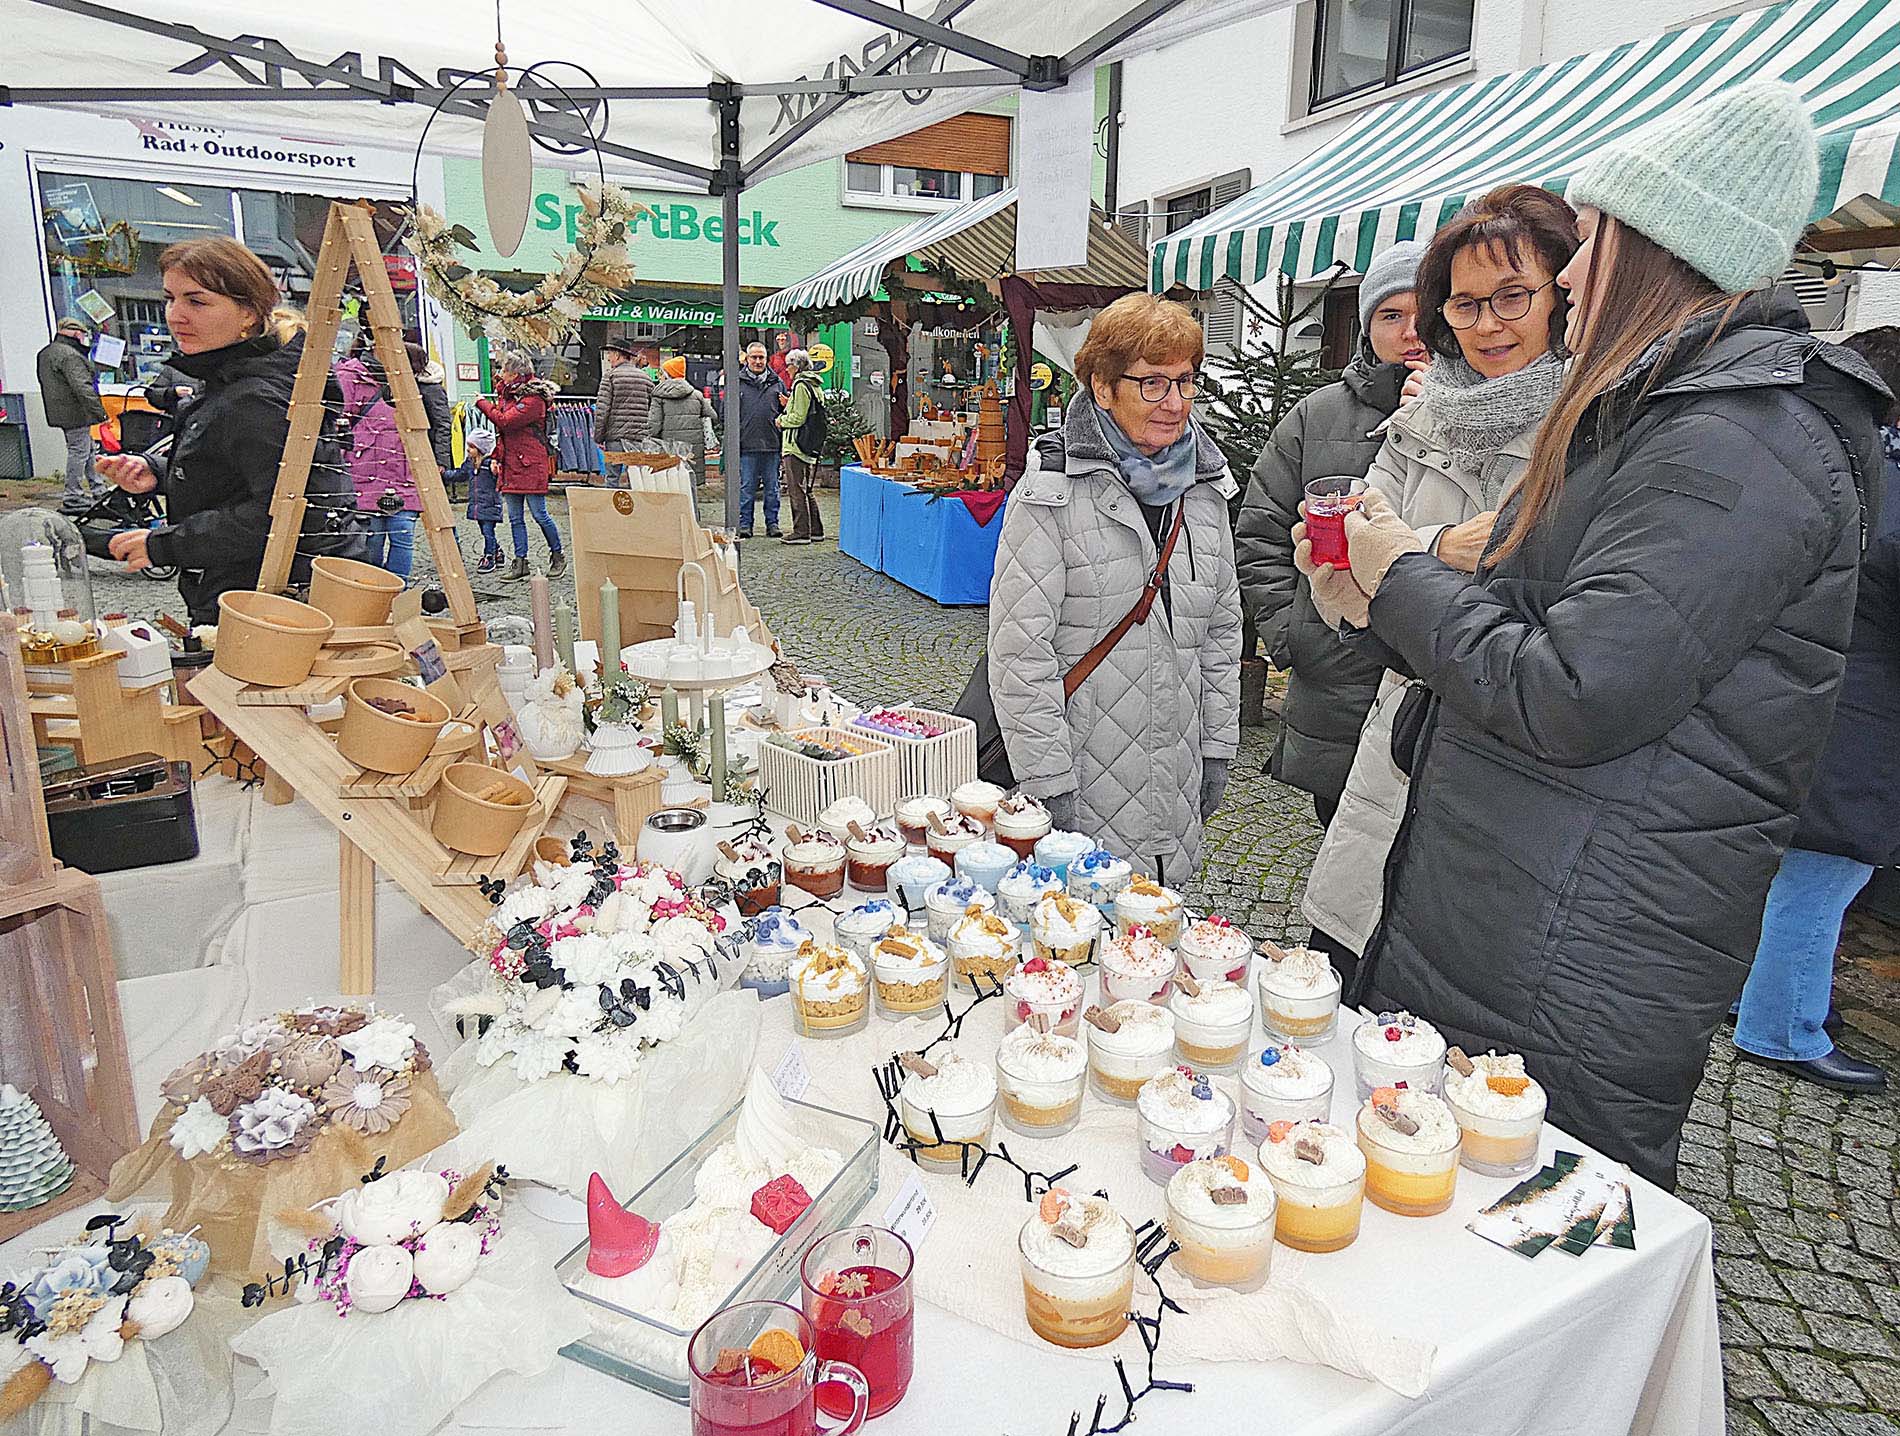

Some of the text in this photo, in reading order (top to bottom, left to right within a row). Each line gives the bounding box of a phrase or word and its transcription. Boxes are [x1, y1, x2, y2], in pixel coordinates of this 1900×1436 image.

[143, 135, 186, 151] Rad
[203, 140, 356, 168] Outdoorsport
[534, 193, 780, 247] SprtBeck
